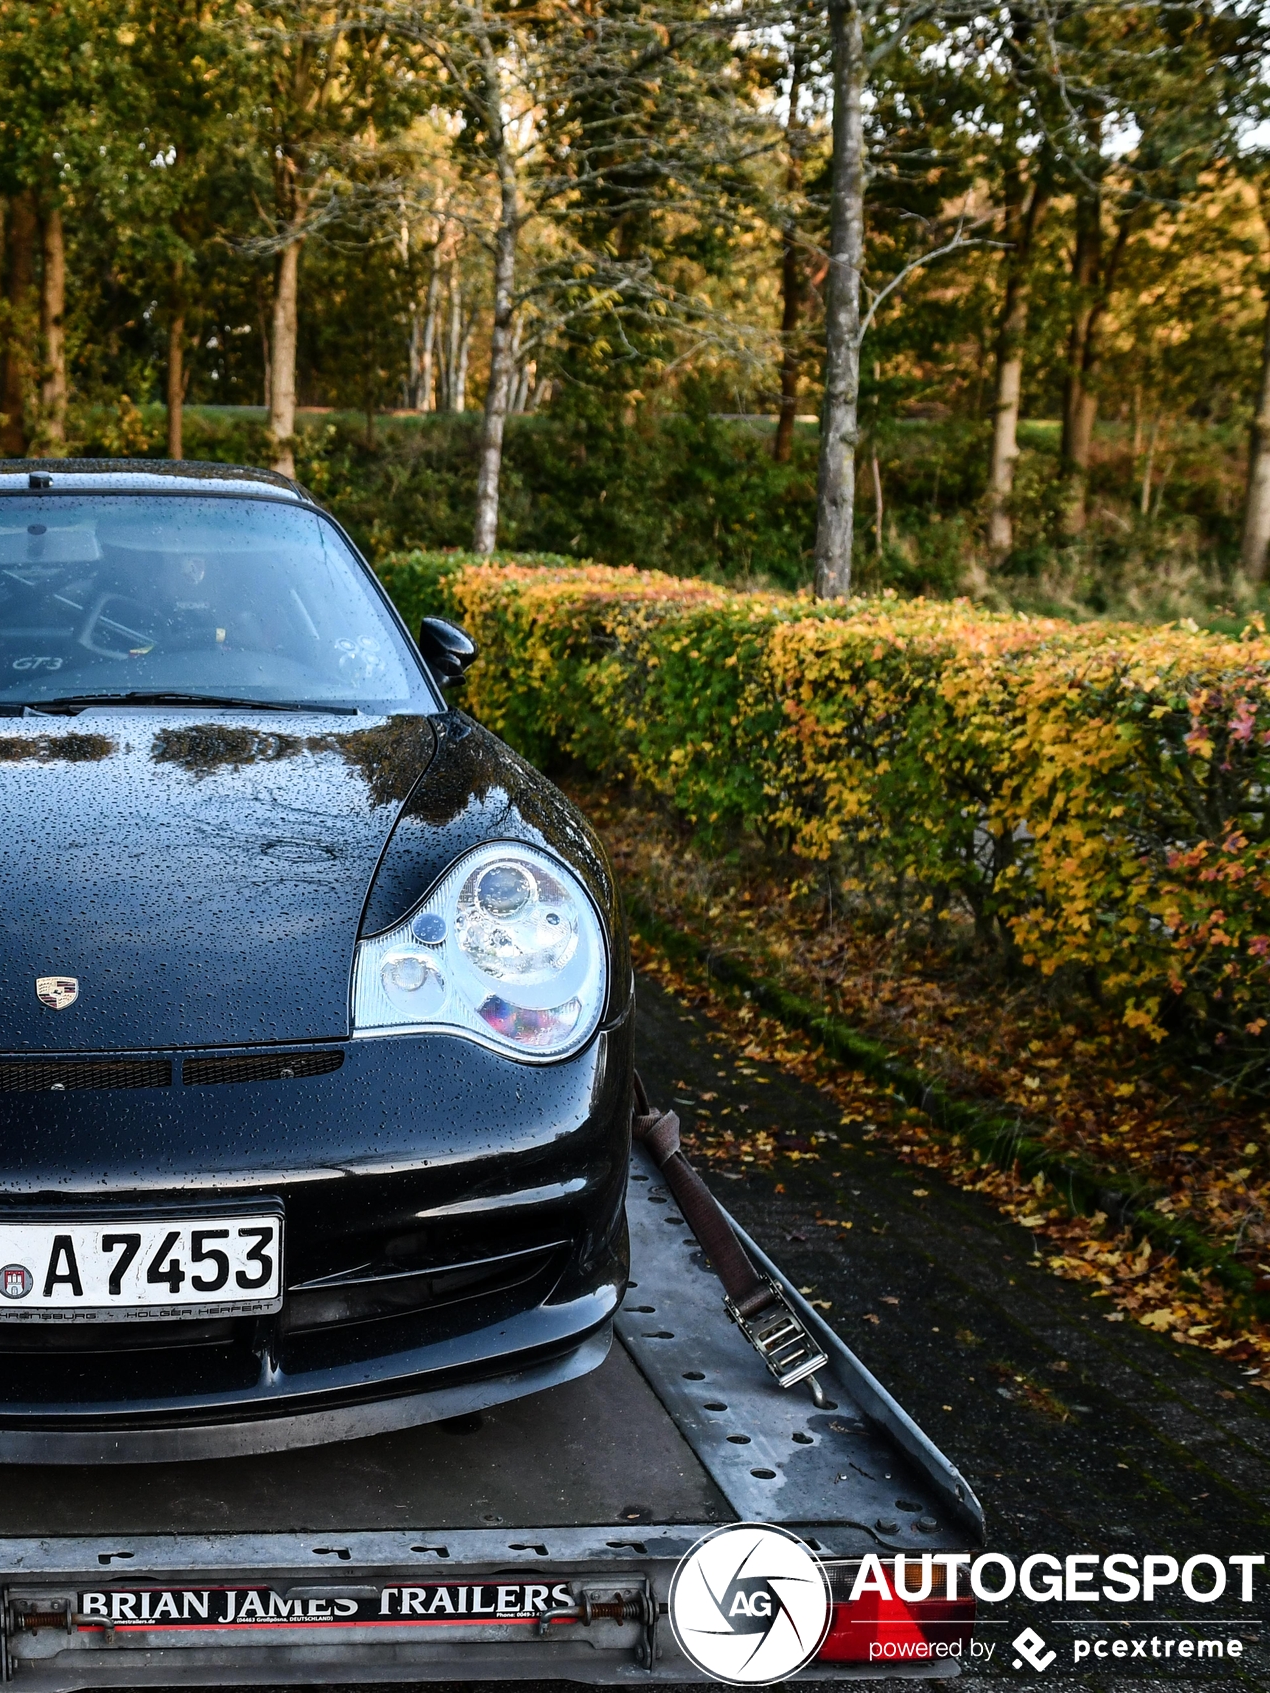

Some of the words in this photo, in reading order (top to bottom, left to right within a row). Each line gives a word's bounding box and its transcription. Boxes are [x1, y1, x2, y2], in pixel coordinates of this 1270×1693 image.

[12, 656, 64, 670] GT3
[42, 1234, 84, 1298] A
[100, 1226, 275, 1295] 7453
[126, 1308, 192, 1318] HOLGER
[82, 1591, 211, 1619] BRIAN
[217, 1590, 359, 1624] JAMES
[378, 1583, 576, 1615] TRAILERS
